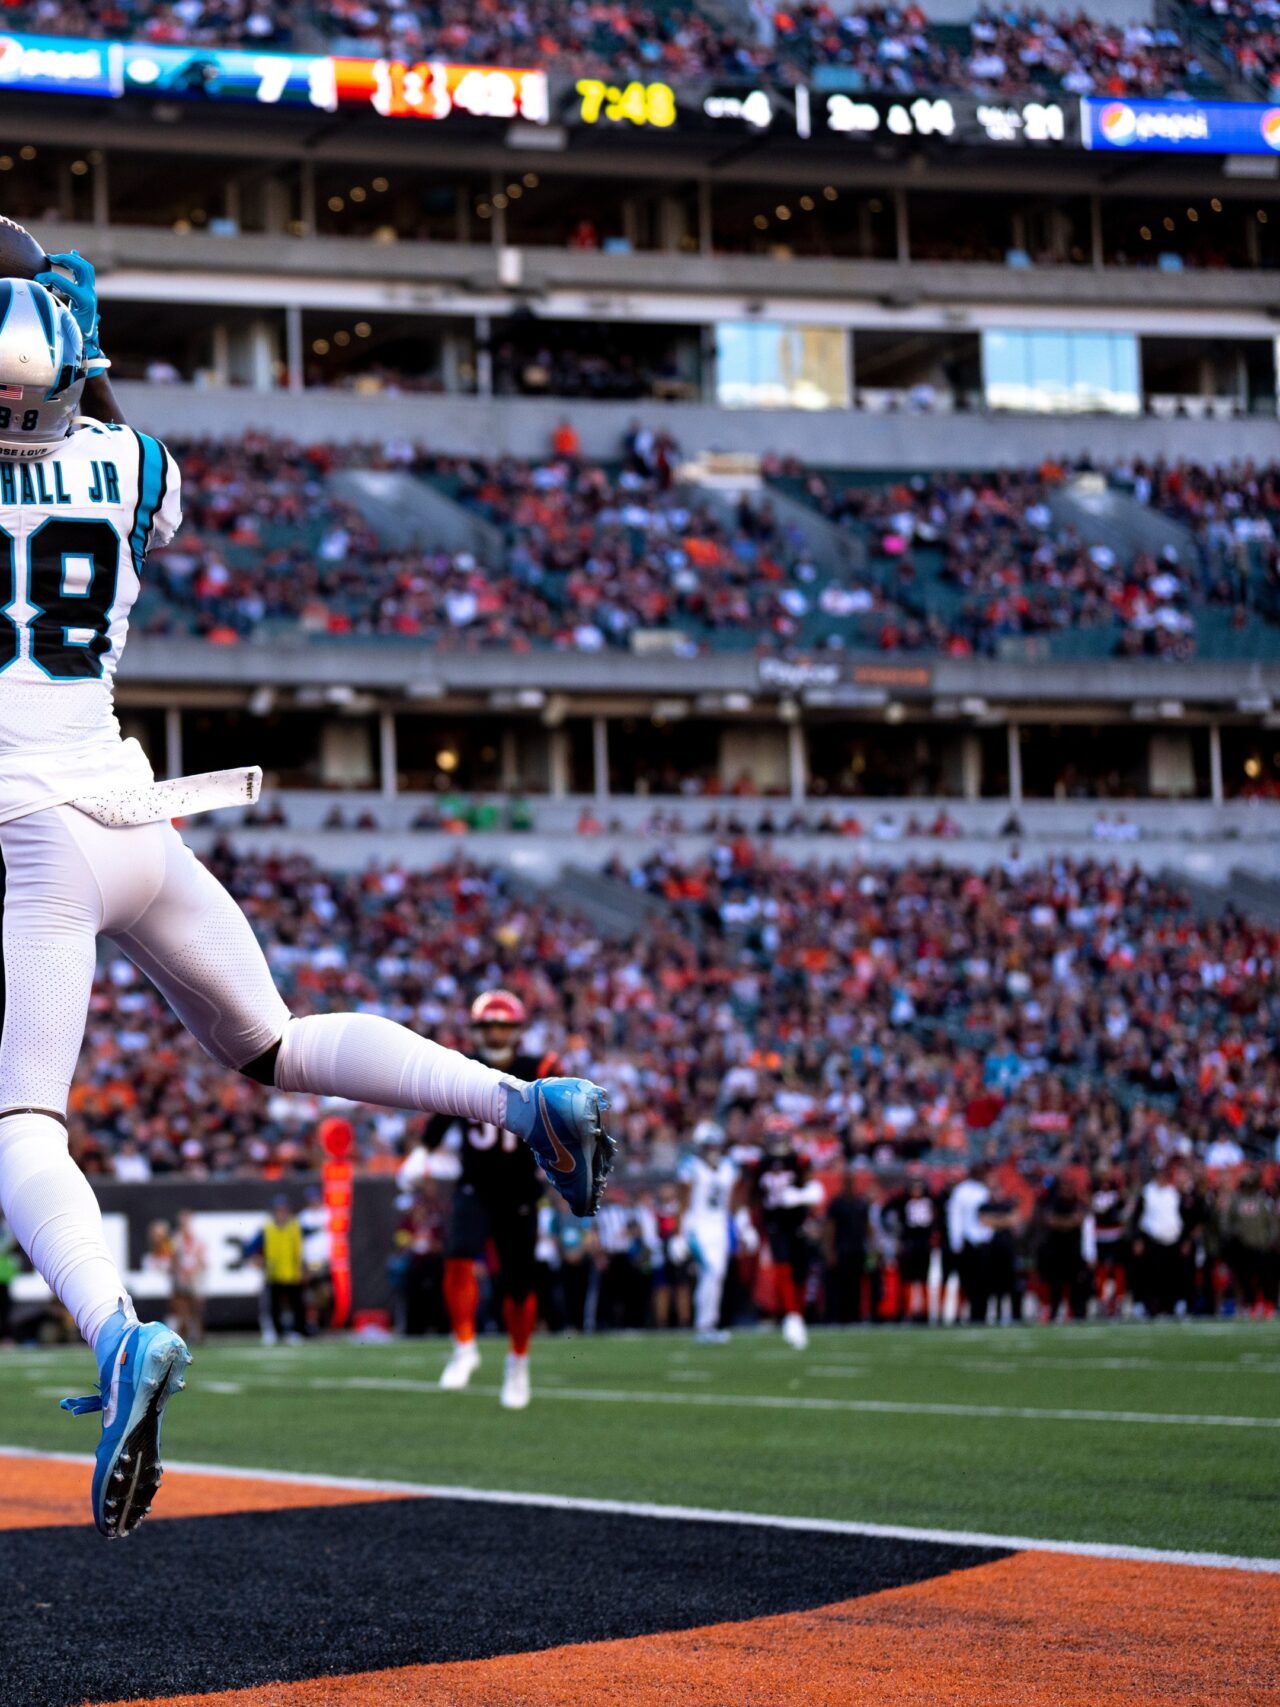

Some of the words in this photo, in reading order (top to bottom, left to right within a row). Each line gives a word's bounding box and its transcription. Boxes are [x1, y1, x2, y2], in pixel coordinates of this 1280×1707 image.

[253, 57, 291, 103] 7
[19, 448, 48, 457] LOVE
[88, 460, 121, 505] JR
